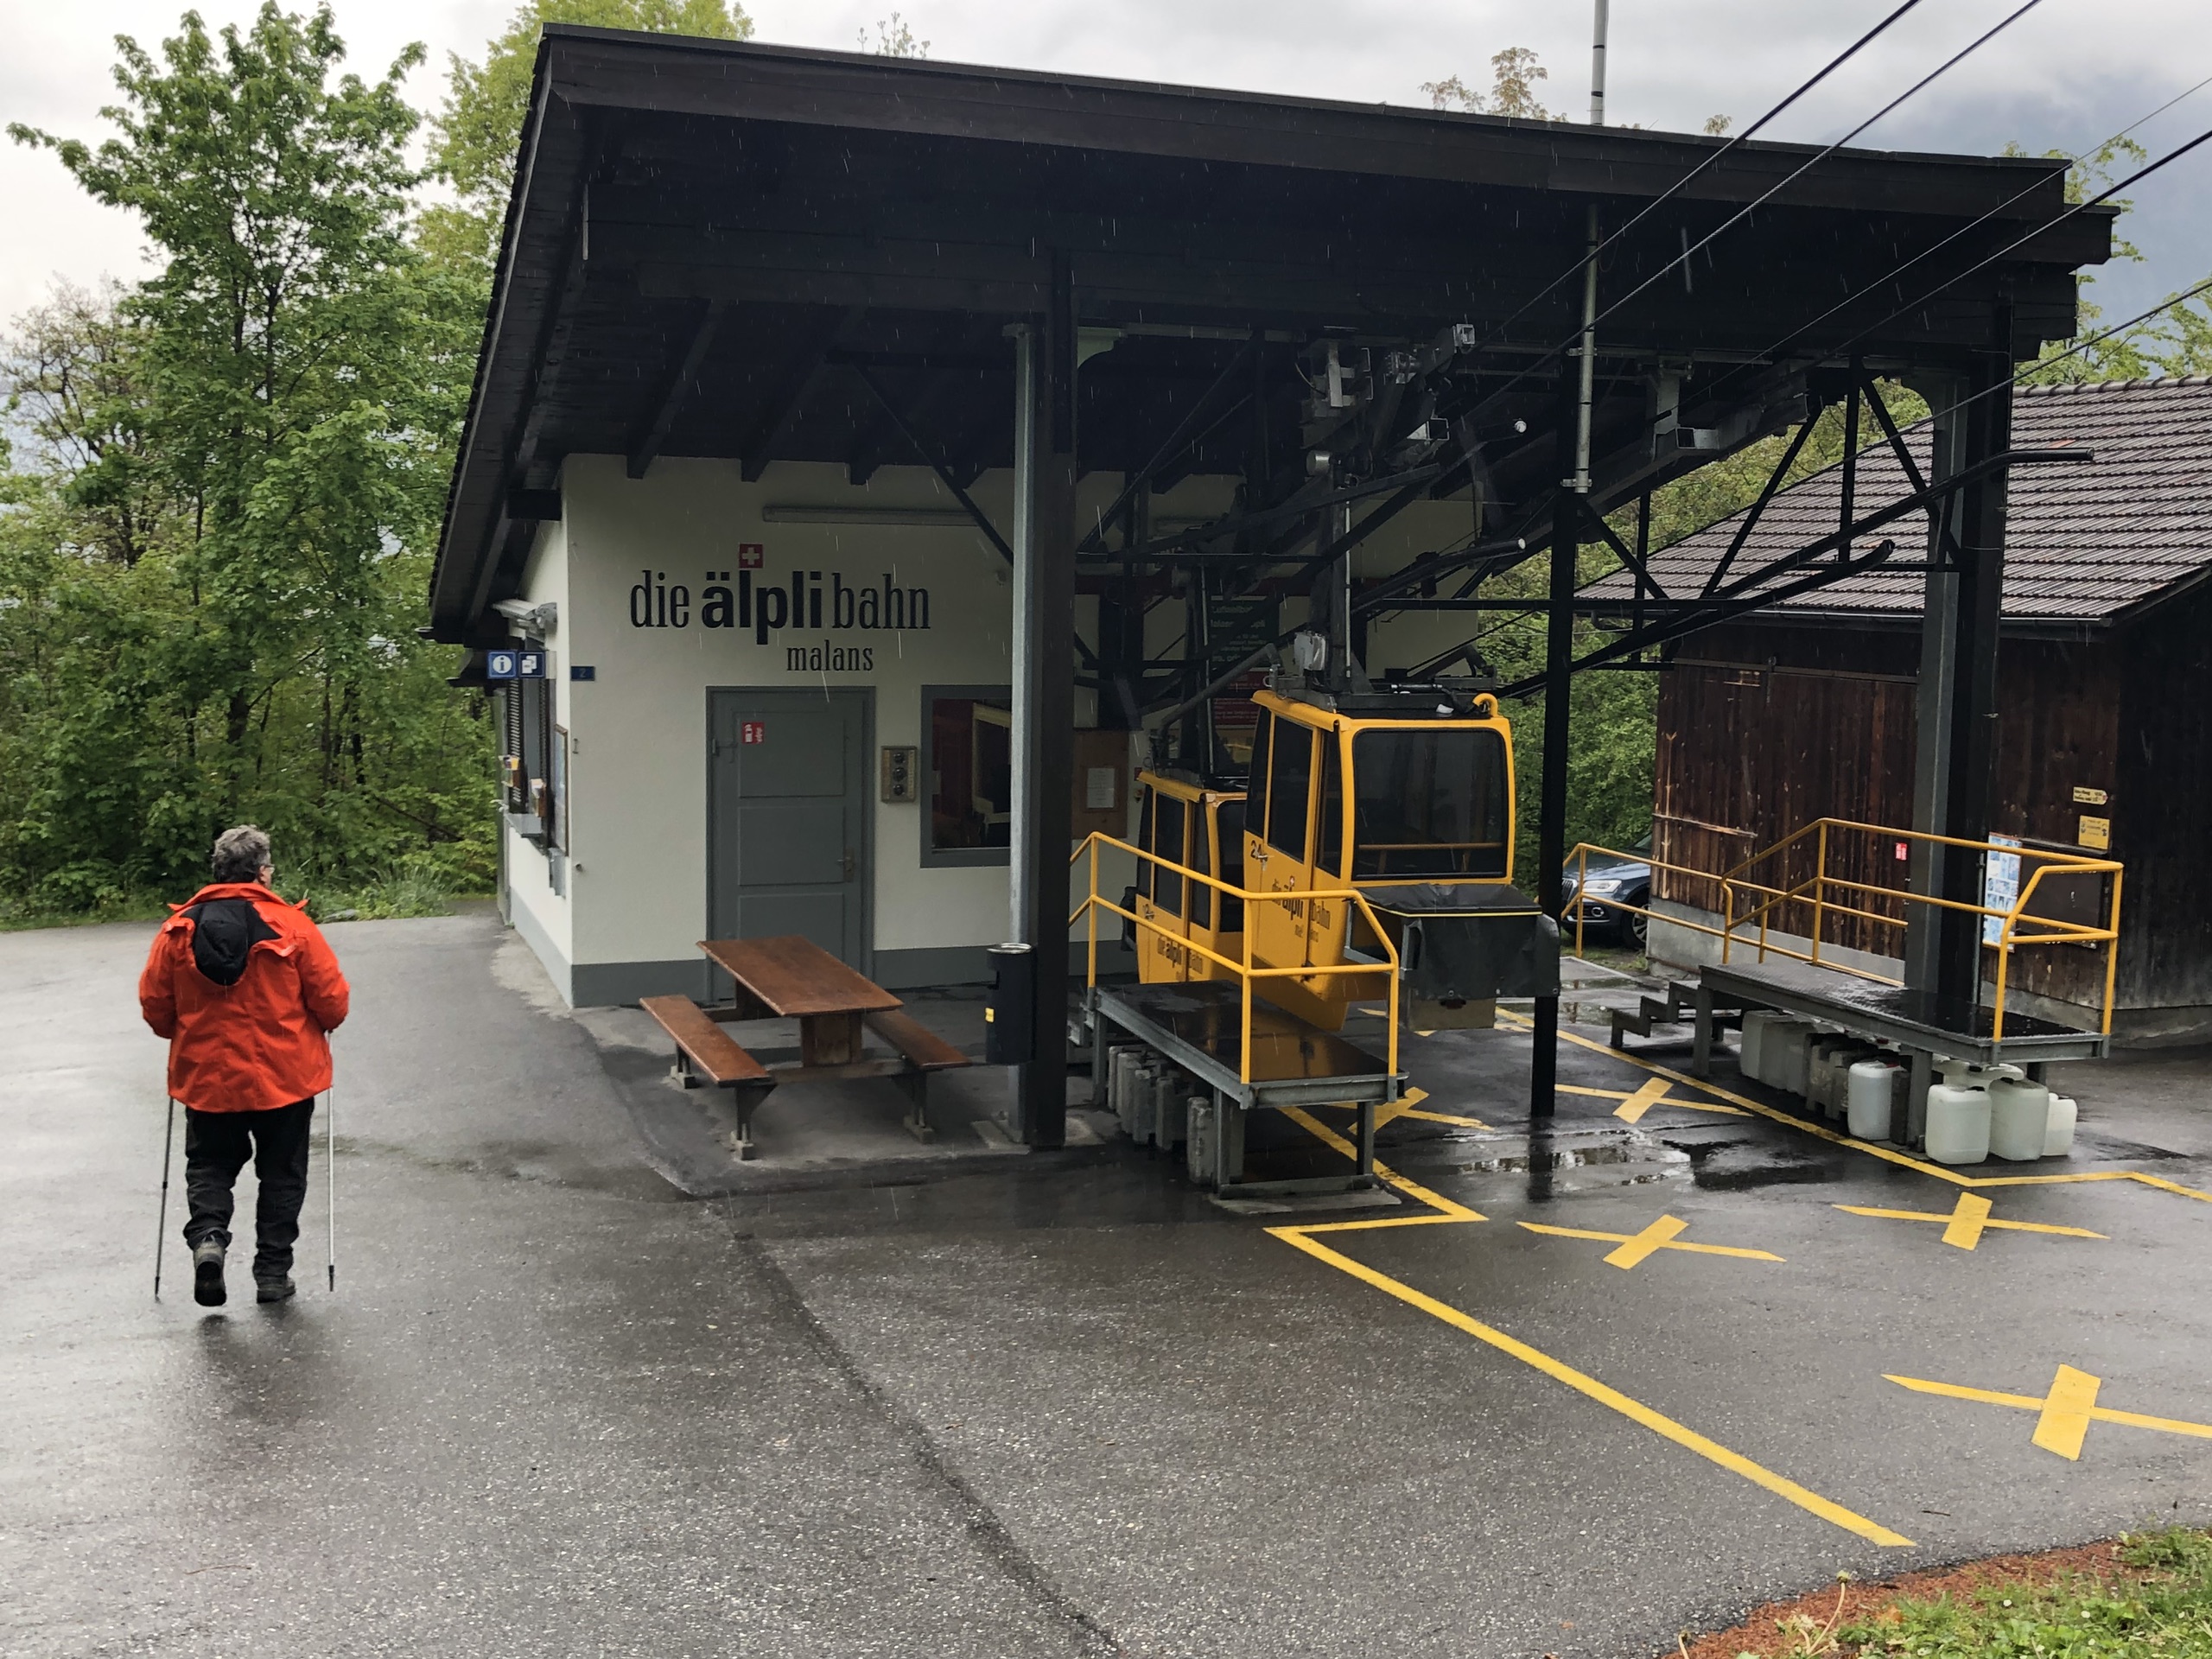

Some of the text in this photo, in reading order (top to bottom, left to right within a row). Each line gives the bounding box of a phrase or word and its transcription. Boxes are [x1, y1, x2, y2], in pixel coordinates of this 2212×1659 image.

[630, 570, 931, 645] die älpli bahn
[786, 639, 874, 671] malans
